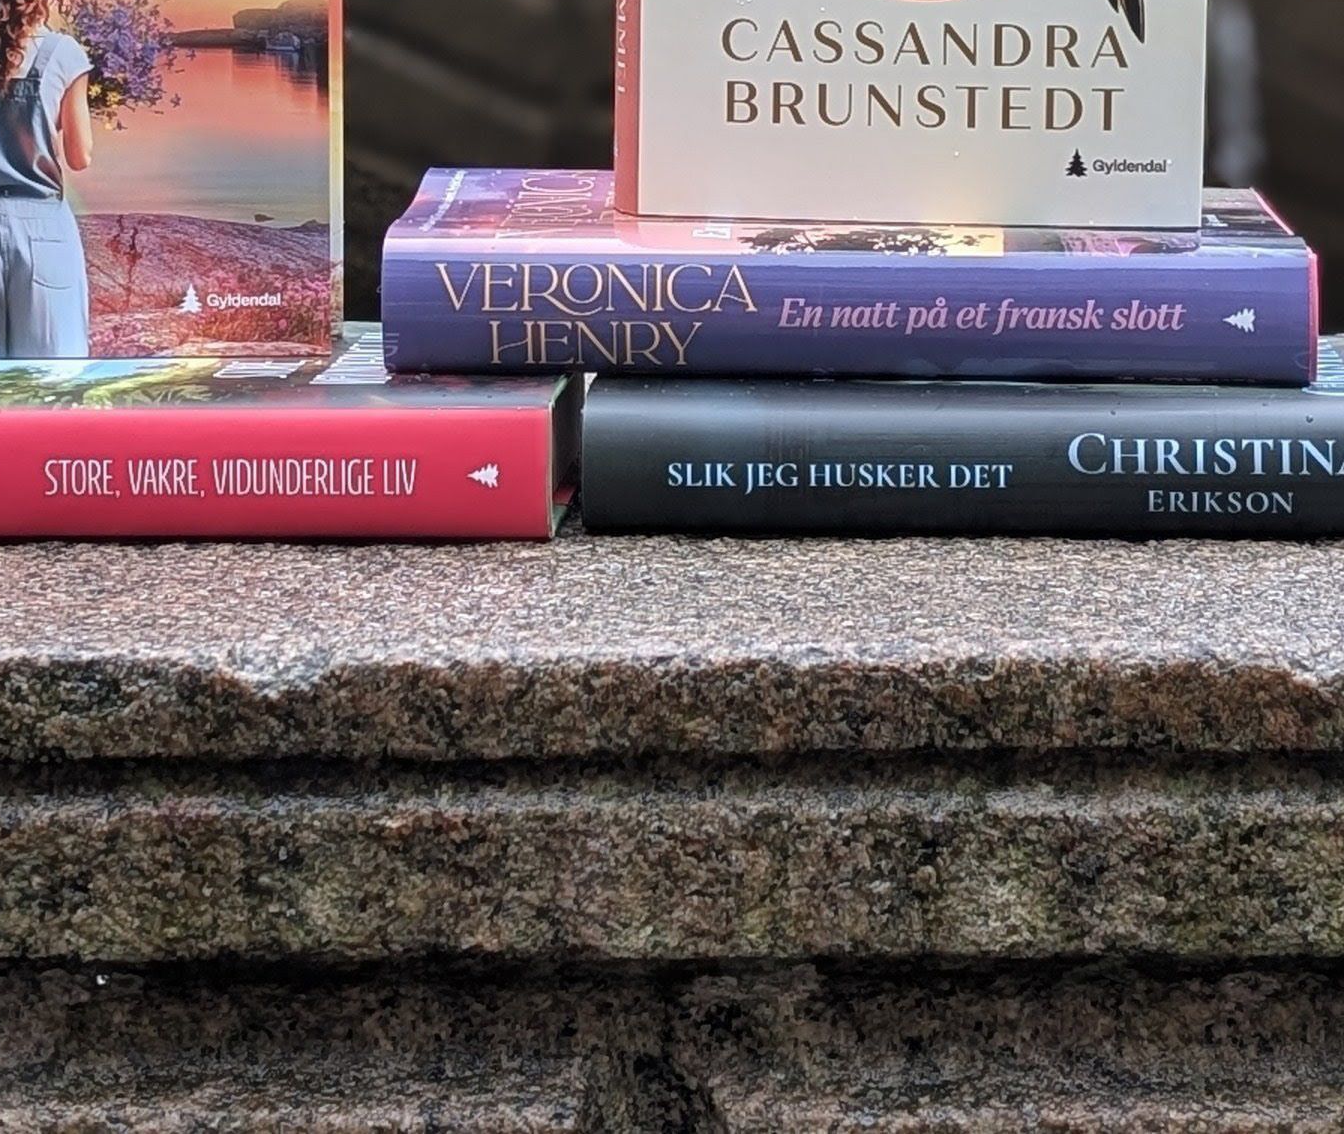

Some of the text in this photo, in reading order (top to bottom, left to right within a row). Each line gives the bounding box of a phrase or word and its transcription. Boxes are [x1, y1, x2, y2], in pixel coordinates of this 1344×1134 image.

[721, 18, 1129, 69] CASSANDRA
[725, 80, 1126, 132] BRUNSTEDT
[1092, 159, 1168, 176] Gyldendal
[206, 291, 282, 312] Gyldendal
[436, 263, 757, 314] VERONICA
[778, 294, 1184, 336] En natt på et fransk slott
[489, 320, 702, 365] HENRY
[45, 458, 416, 500] STORE, VAKRE, VIDUNDERLIGE LIV
[667, 462, 1013, 493] SLIK JEG HUSKER DET
[1147, 490, 1294, 515] ERIKSON
